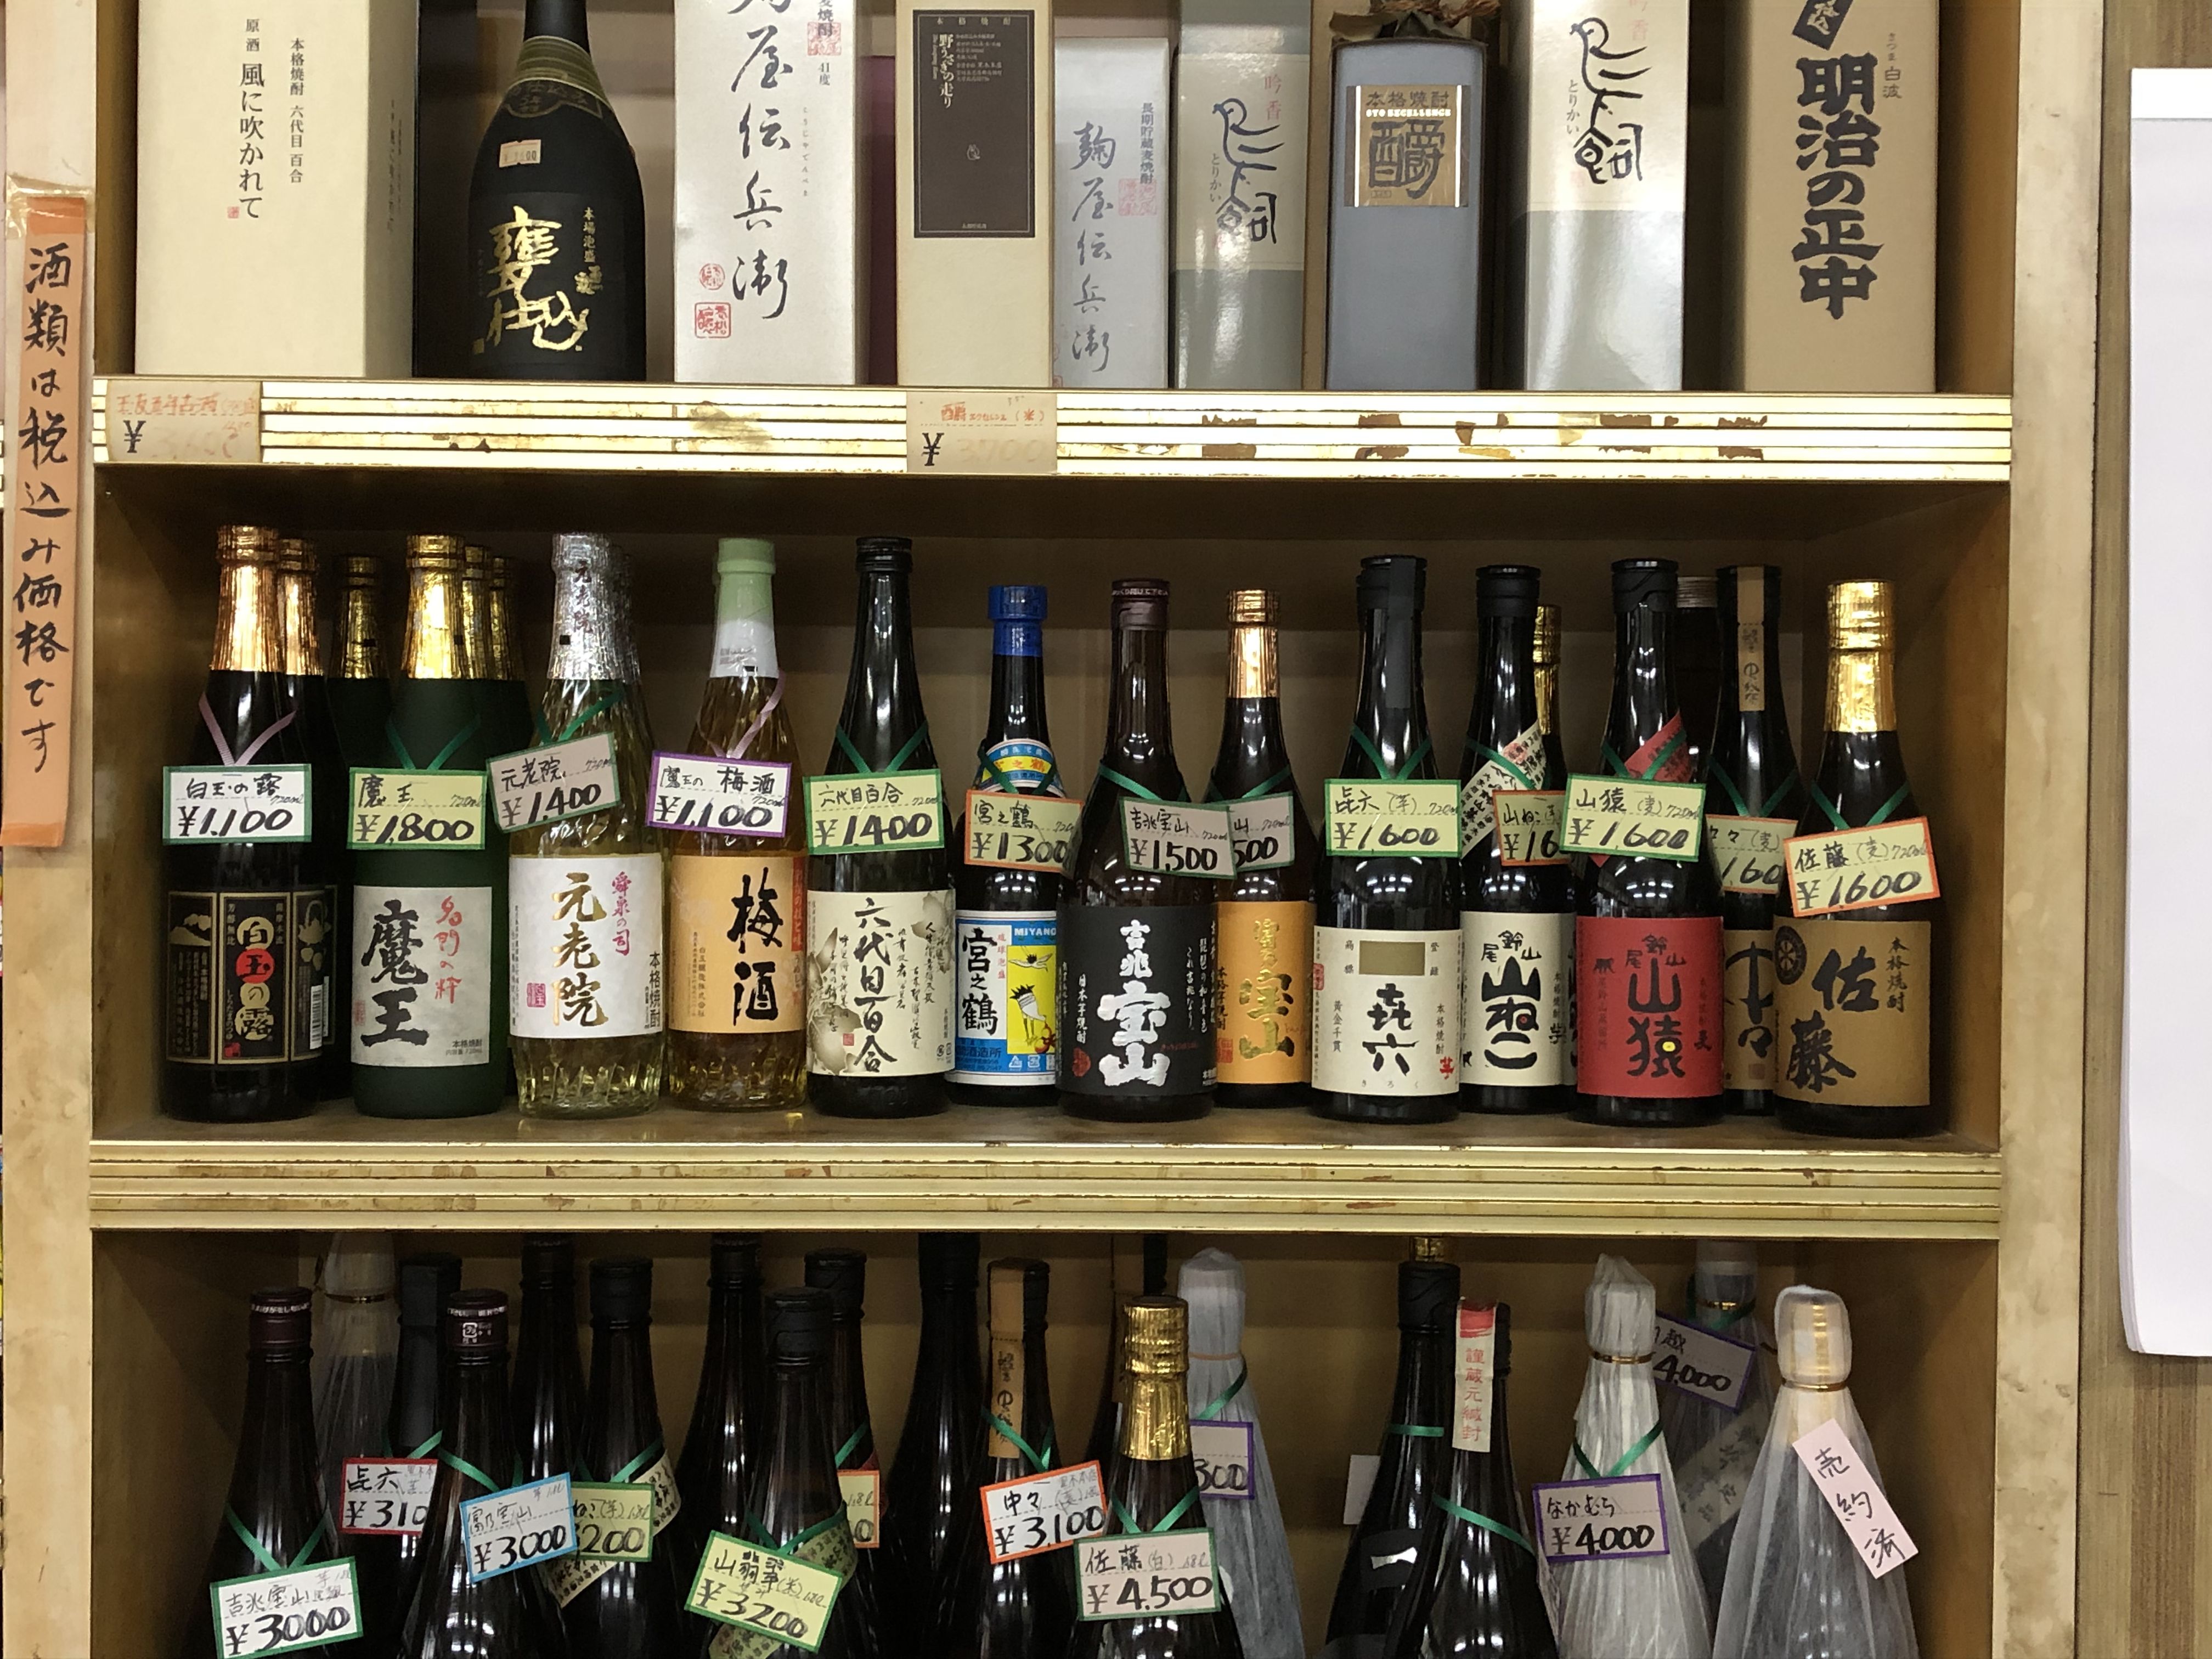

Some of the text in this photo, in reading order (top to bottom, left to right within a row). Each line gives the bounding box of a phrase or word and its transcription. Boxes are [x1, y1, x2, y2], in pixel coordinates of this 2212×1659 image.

[818, 62, 831, 86] 41度
[939, 33, 955, 109] 野うさぎの走り
[1367, 91, 1449, 108] 本格焼酎
[239, 19, 264, 219] 原酒 風に吹かれて
[290, 38, 304, 184] 本格焼酎 六代目 百合
[1566, 80, 1580, 134] とりかい
[728, 0, 793, 319] 屋伝兵衛
[1139, 102, 1155, 184] 長期貯蔵麦焼酎
[1209, 153, 1222, 203] とりかい
[1791, 52, 1884, 320] 明治の正中
[583, 206, 596, 263] 本場泡盛
[13, 241, 71, 772] 酒類は税込み価格です
[186, 772, 282, 799] 白玉の露
[358, 774, 414, 808] 魔王
[501, 756, 567, 792] 元老院
[818, 781, 904, 808] 六代目百合
[1576, 788, 1662, 815] 山猿 (麦)
[974, 799, 1034, 829] 宮之鶴
[1503, 803, 1541, 825] 山ねこ
[1795, 840, 1849, 873] 佐藤
[360, 898, 429, 1047] 魔王
[434, 895, 462, 1004] 名門の粋
[551, 872, 608, 1026] 元老院
[727, 867, 783, 1026] 梅酒
[997, 933, 1006, 979] 琉球泡盛
[1481, 930, 1542, 962] 尾鈴山
[1625, 934, 1686, 968] 尾鈴山
[235, 916, 274, 1040] 白玉の露
[650, 951, 661, 1028] 本格焼酎
[853, 897, 898, 1073] 六代目百合
[962, 927, 998, 1036] 宮之鶴
[1097, 919, 1171, 1086] 吉兆宝山
[1239, 918, 1295, 1059] 富乃宝山
[1886, 936, 1910, 1014] 本格焼酎
[452, 1039, 482, 1048] 本格焼酎
[1333, 1000, 1342, 1052] 黄金千貫
[1626, 956, 1686, 1078] 山猿
[1786, 946, 1879, 1093] 佐藤
[1361, 1079, 1419, 1088] きろく
[467, 1502, 532, 1535] 富乃宝山
[1547, 1494, 1615, 1519] なかむら
[1814, 1447, 1906, 1568] 売約済
[1085, 1544, 1142, 1574] 佐藤
